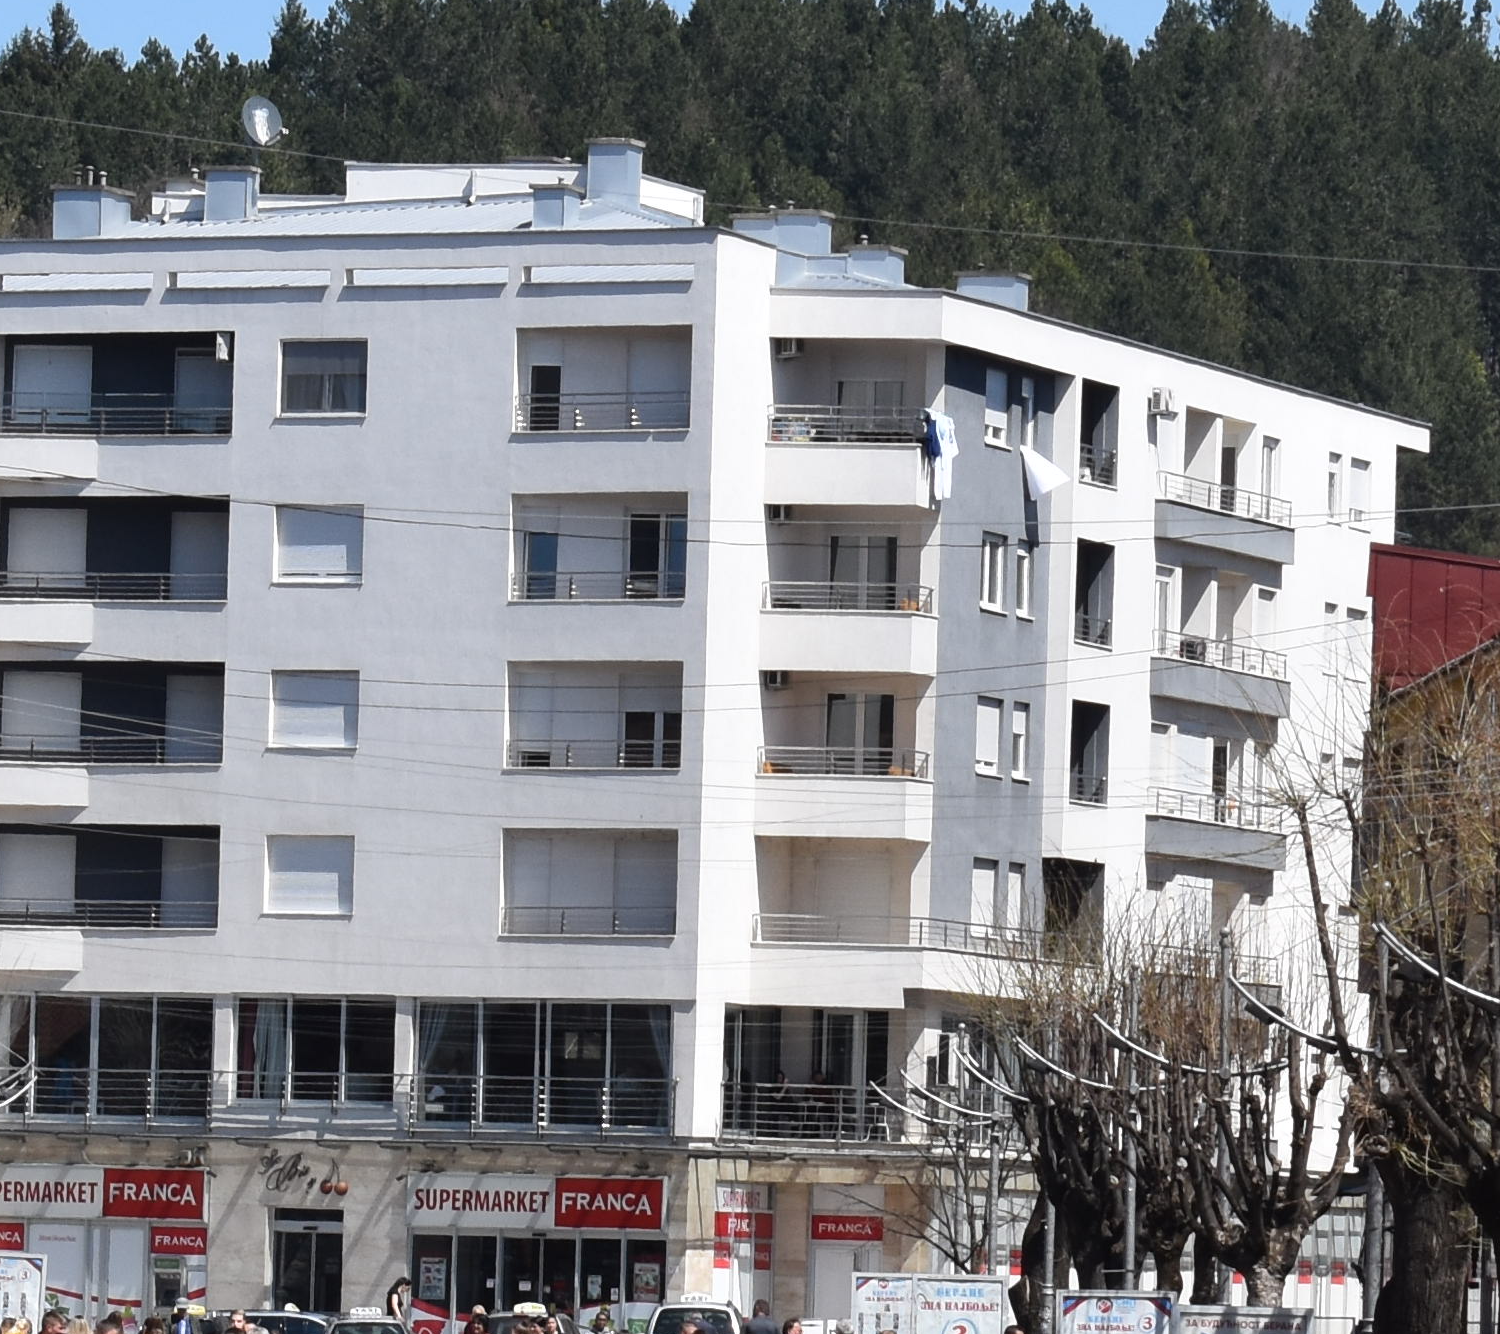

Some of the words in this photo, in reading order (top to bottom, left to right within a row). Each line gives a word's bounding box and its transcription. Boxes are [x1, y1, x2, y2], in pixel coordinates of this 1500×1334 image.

[109, 1182, 196, 1205] FRANCA
[414, 1188, 549, 1213] SUPERMARKET
[561, 1192, 651, 1216] FRANCA
[818, 1222, 872, 1235] FRANCA
[154, 1235, 204, 1248] FRANCA
[21, 1270, 28, 1279] 3
[1142, 1317, 1153, 1330] 3
